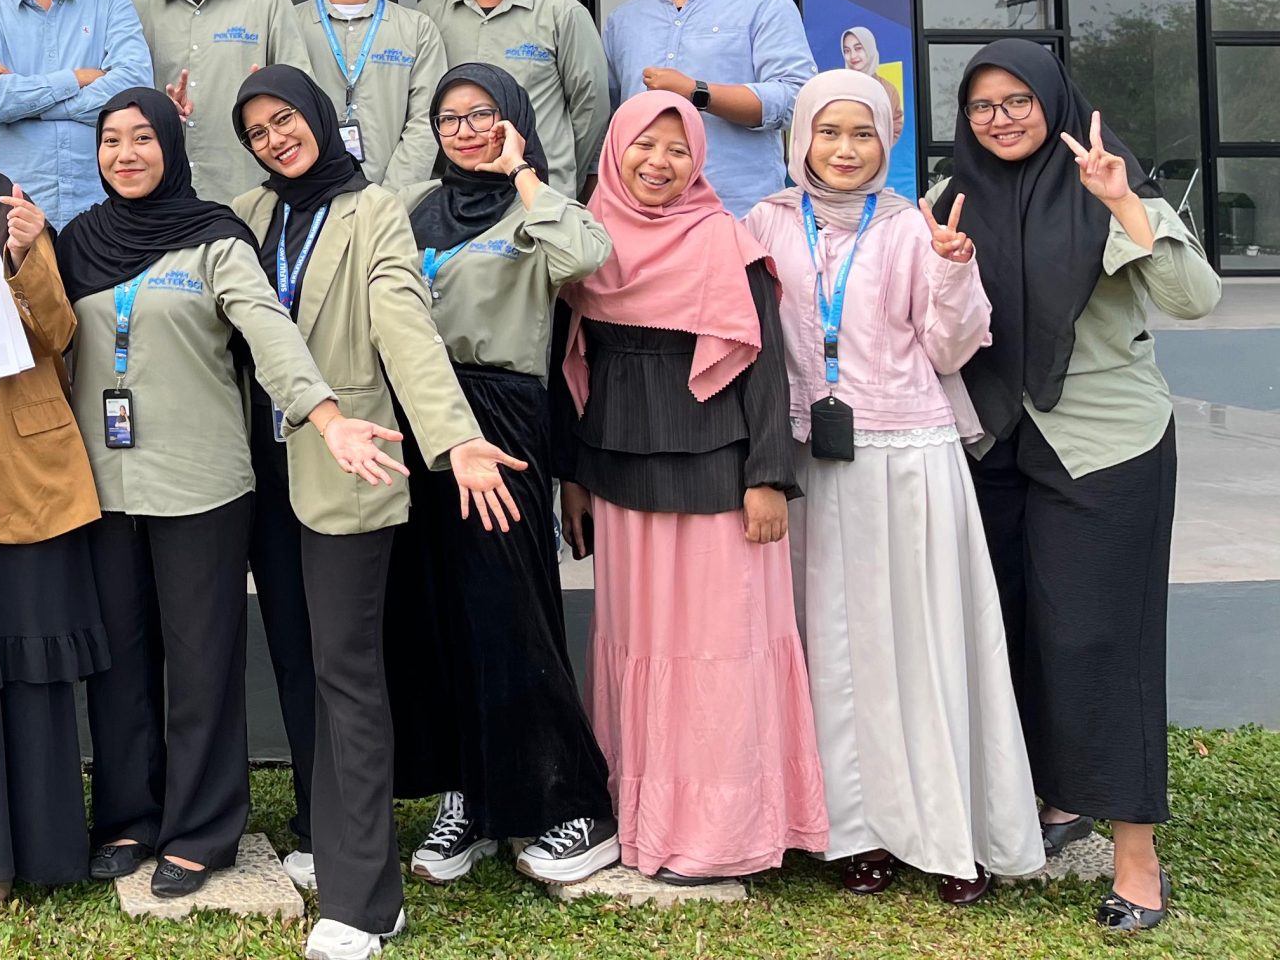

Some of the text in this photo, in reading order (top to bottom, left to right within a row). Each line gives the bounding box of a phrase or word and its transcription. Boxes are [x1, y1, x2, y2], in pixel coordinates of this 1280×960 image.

[147, 277, 203, 290] POLTEK SCI
[280, 262, 288, 292] SKILFULL
